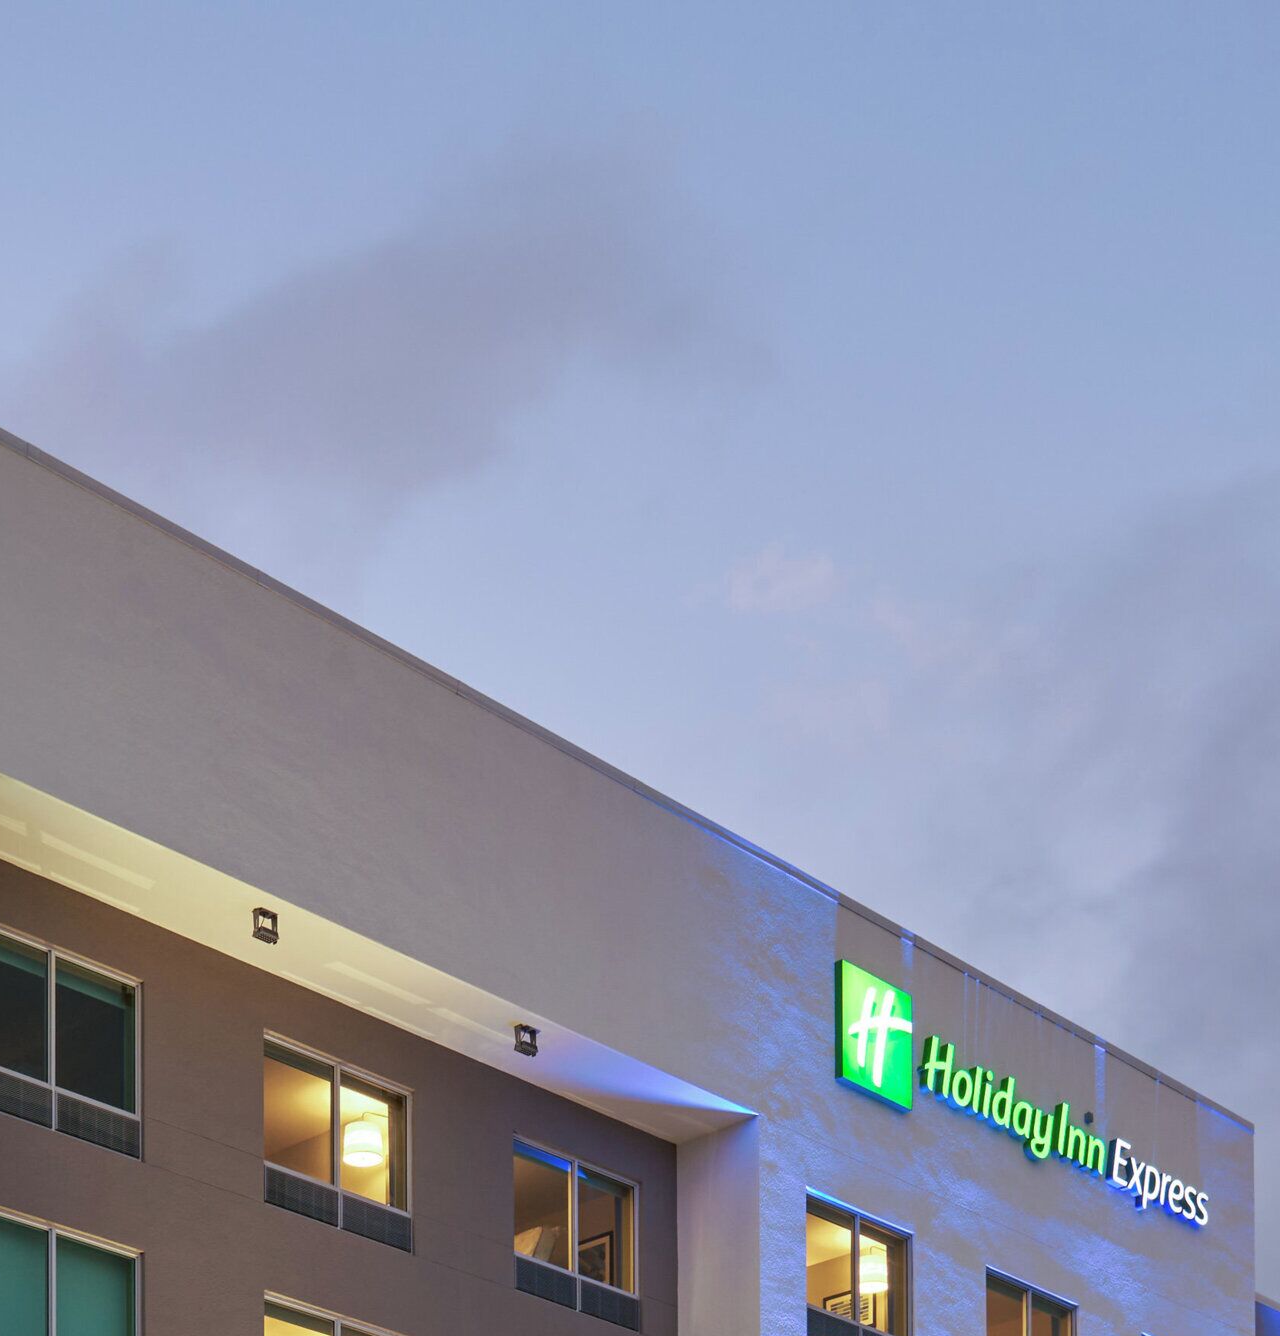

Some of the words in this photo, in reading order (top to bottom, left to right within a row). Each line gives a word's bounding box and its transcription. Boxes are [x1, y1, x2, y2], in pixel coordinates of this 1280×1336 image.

[924, 1034, 1055, 1160] Holiday
[1057, 1100, 1106, 1176] Inn
[1111, 1137, 1210, 1226] Express
